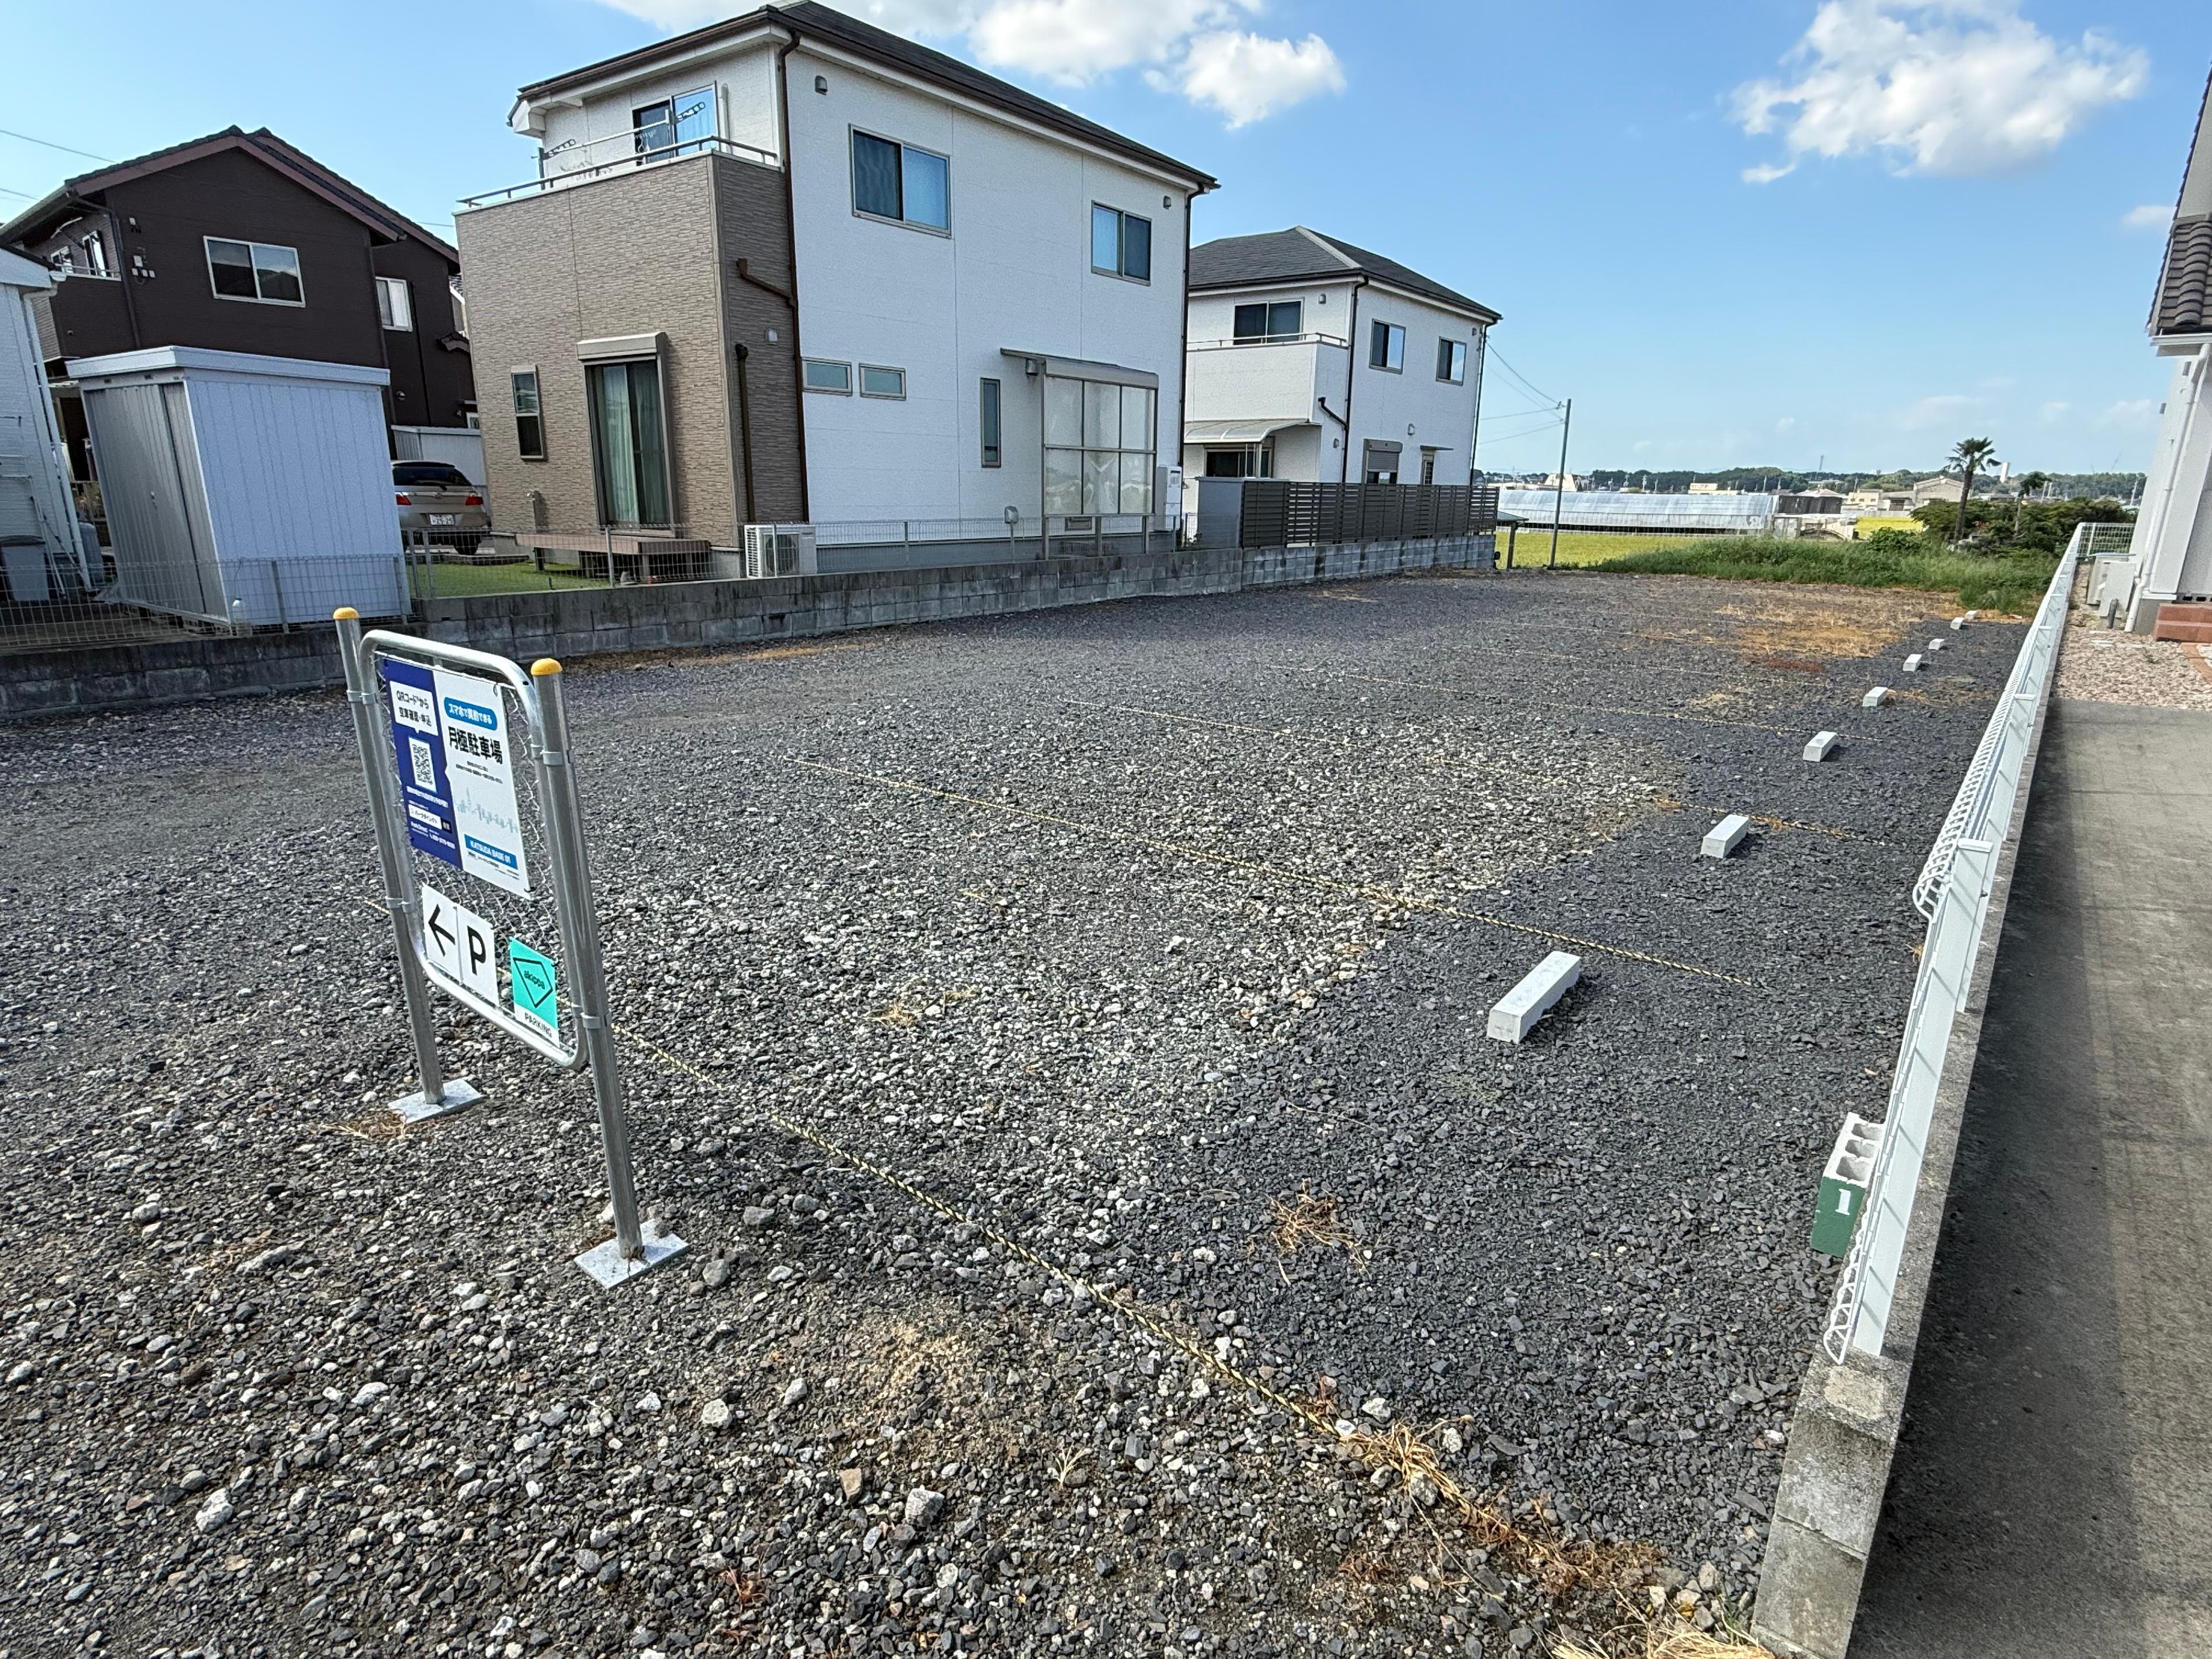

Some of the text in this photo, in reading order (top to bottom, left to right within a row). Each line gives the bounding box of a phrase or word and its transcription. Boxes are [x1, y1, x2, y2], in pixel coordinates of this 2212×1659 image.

[448, 726, 503, 765] 月極駐車場
[467, 925, 486, 976] P
[525, 1012, 552, 1038] PARKING
[1835, 1188, 1851, 1216] 1
